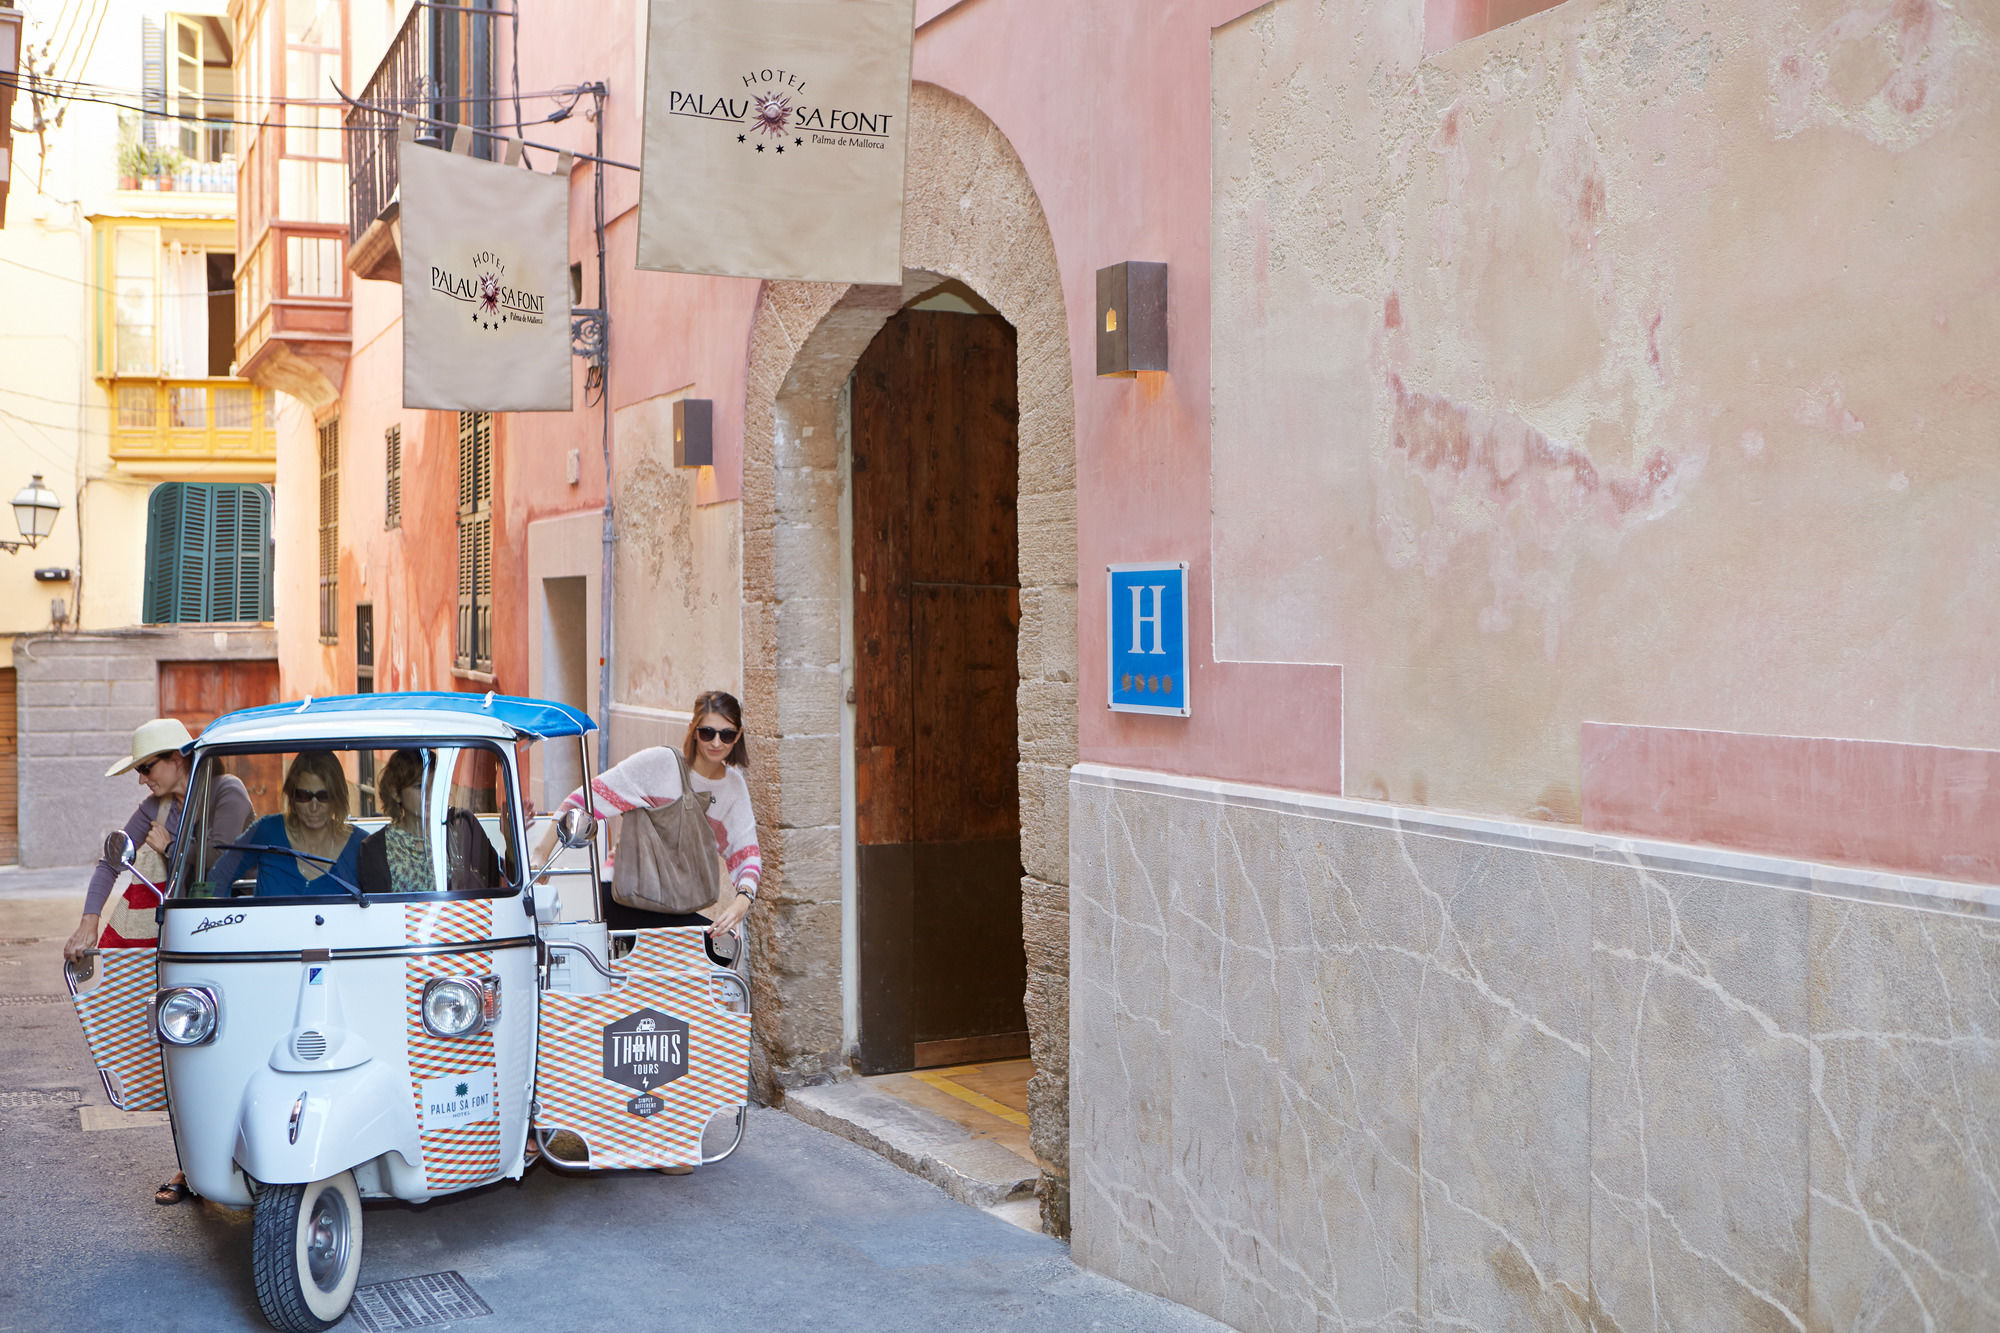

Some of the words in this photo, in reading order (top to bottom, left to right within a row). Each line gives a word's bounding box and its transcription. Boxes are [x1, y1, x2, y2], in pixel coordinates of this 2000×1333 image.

[742, 69, 806, 95] HOTEL
[669, 90, 749, 119] PALAU
[795, 106, 824, 128] SA
[830, 109, 893, 134] FONT
[812, 134, 836, 145] Palma
[837, 137, 847, 146] de
[849, 138, 885, 150] Mallorca
[472, 251, 505, 276] HOTEL
[431, 266, 478, 299] PALAU
[501, 286, 516, 306] SA
[517, 290, 545, 311] FONT
[1128, 585, 1167, 655] H
[612, 1034, 681, 1068] THOMAS
[633, 1063, 659, 1075] TOURS
[430, 1101, 457, 1115] PALAU
[459, 1099, 469, 1111] SA
[471, 1093, 489, 1108] FONT
[452, 1110, 471, 1118] HOTEL
